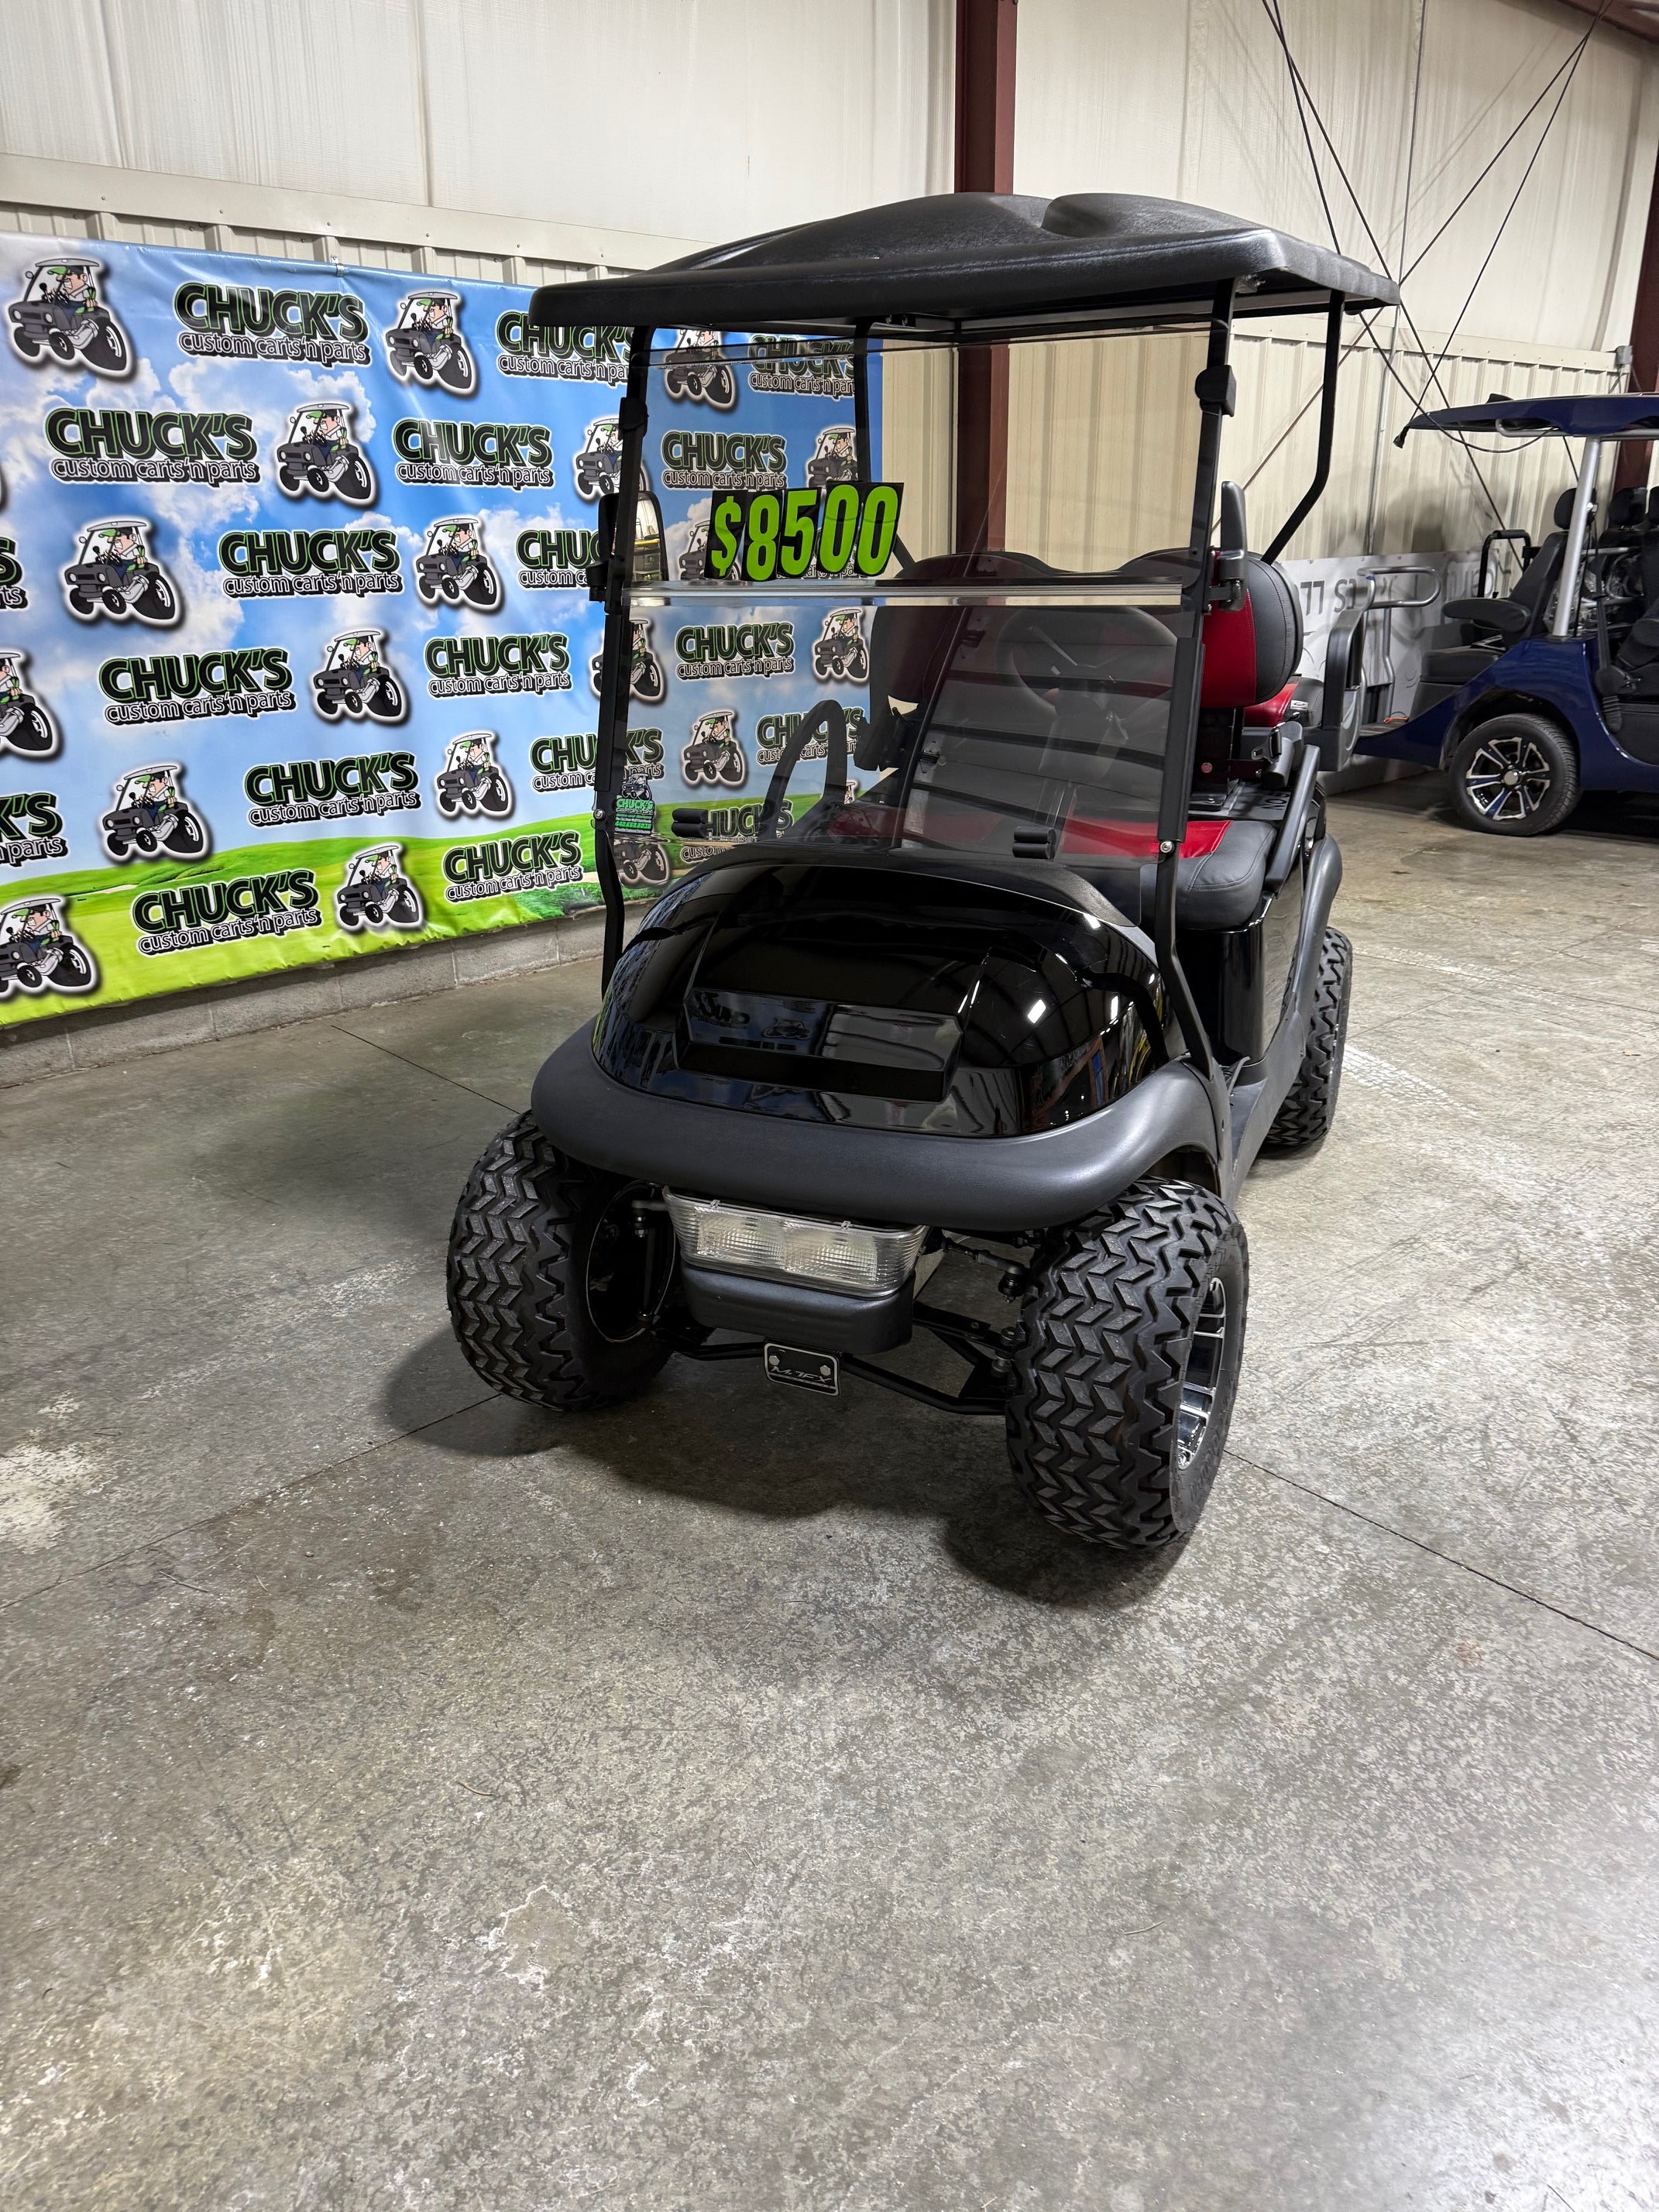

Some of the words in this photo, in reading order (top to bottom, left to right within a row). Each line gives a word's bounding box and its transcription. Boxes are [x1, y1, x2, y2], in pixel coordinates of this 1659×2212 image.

[174, 283, 369, 342] CHUCK'S
[179, 332, 252, 356] custom
[321, 341, 367, 364] parts
[498, 355, 555, 375] custom
[750, 373, 792, 390] custom
[45, 407, 257, 460] CHUCK'S
[393, 419, 552, 467] CHUCK'S
[662, 431, 787, 473] CHUCK'S
[52, 459, 133, 479] custom
[207, 460, 256, 484] parts
[397, 462, 457, 481] custom
[513, 467, 551, 487] parts
[663, 470, 711, 486] custom
[756, 472, 785, 489] parts
[711, 484, 898, 581] $8500
[219, 530, 400, 576] CHUCK'S
[223, 575, 290, 595] custom
[355, 574, 400, 596] parts
[518, 570, 574, 586] custom
[425, 634, 570, 678] CHUCK'S
[675, 623, 795, 663] CHUCK'S
[99, 648, 293, 703] CHUCK'S
[429, 677, 483, 695] custom
[534, 672, 570, 692] parts
[677, 661, 723, 678] custom
[764, 658, 792, 675] parts
[105, 702, 180, 723] custom
[245, 690, 292, 715] parts
[244, 752, 419, 806] CHUCK'S
[533, 771, 583, 790] custom
[249, 804, 316, 825] custom
[376, 791, 417, 814] parts
[5, 836, 64, 864] parts
[443, 831, 582, 883] CHUCK'S
[446, 878, 499, 900] custom
[546, 865, 581, 887] parts
[132, 870, 319, 934] CHUCK'S
[138, 927, 210, 954] custom
[273, 908, 318, 934] parts
